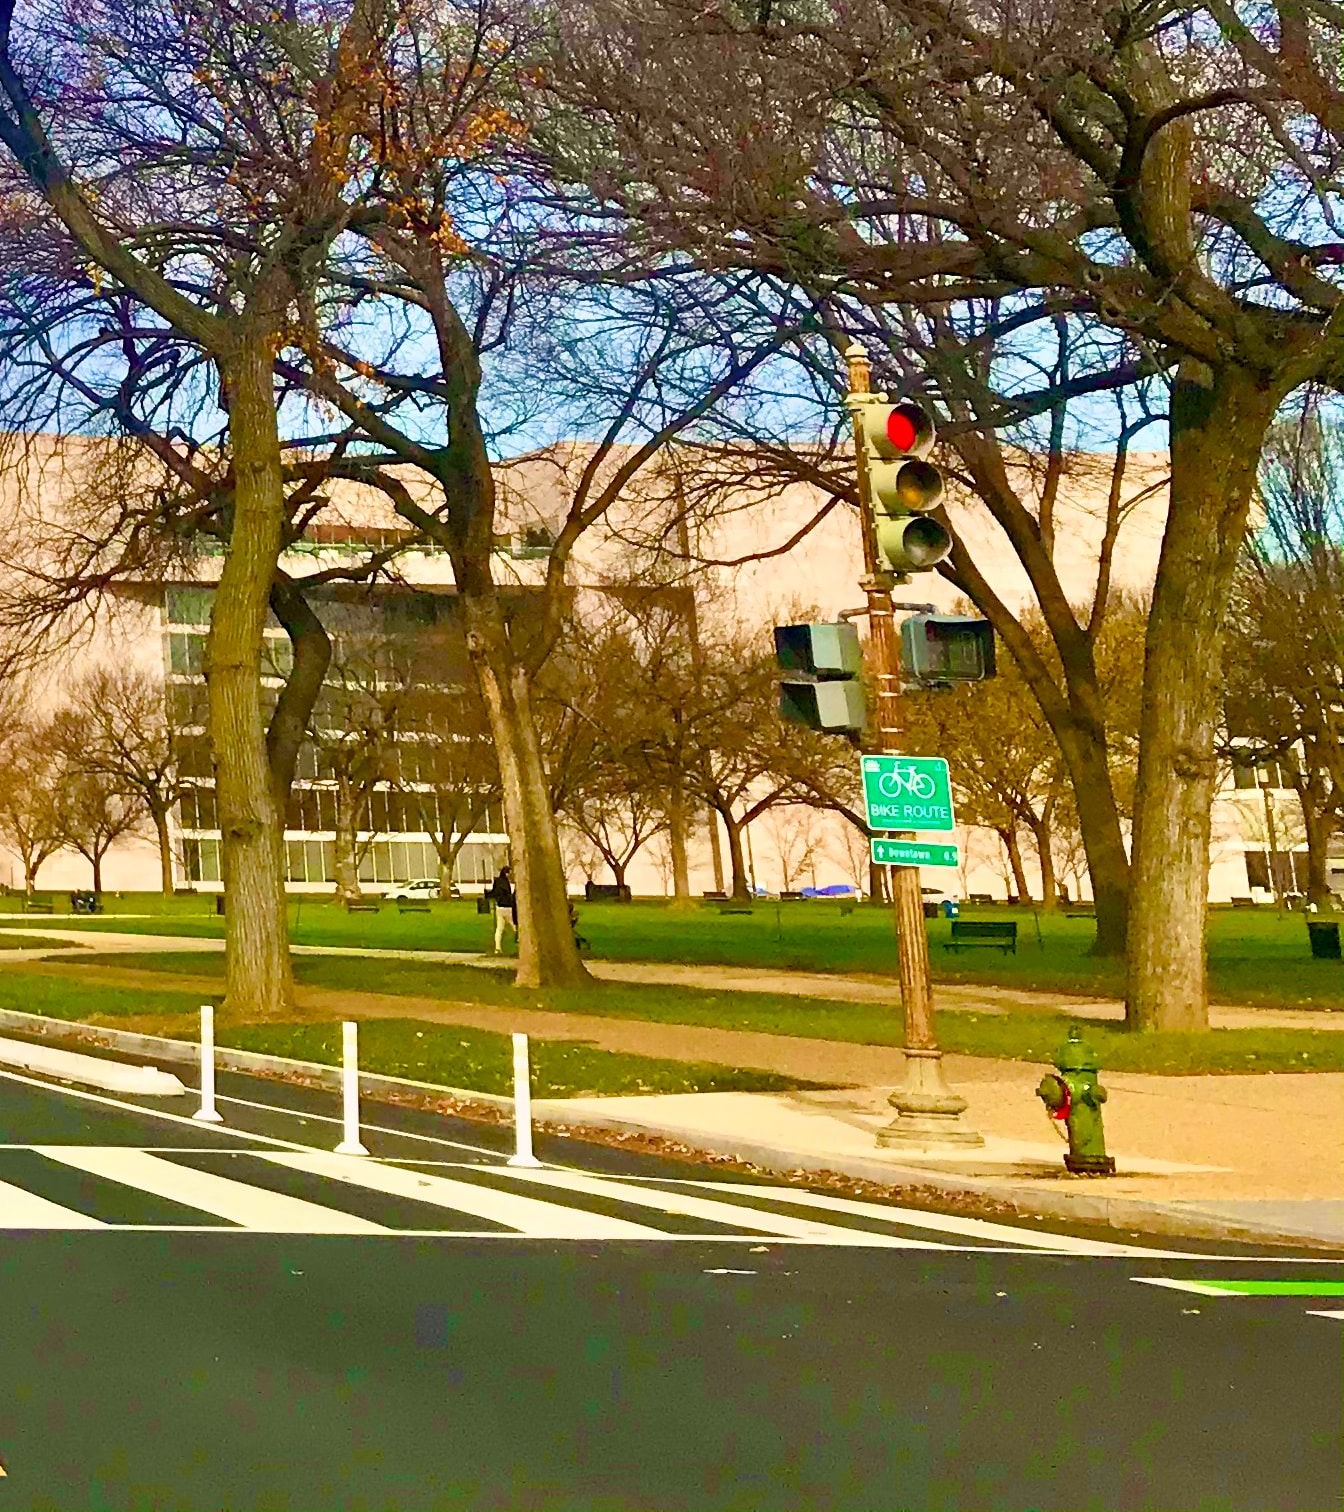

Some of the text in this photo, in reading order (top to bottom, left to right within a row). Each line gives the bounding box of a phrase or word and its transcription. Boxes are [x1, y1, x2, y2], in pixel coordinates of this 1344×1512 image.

[870, 803, 950, 819] BIKE ROUTE
[888, 847, 931, 860] Downtown
